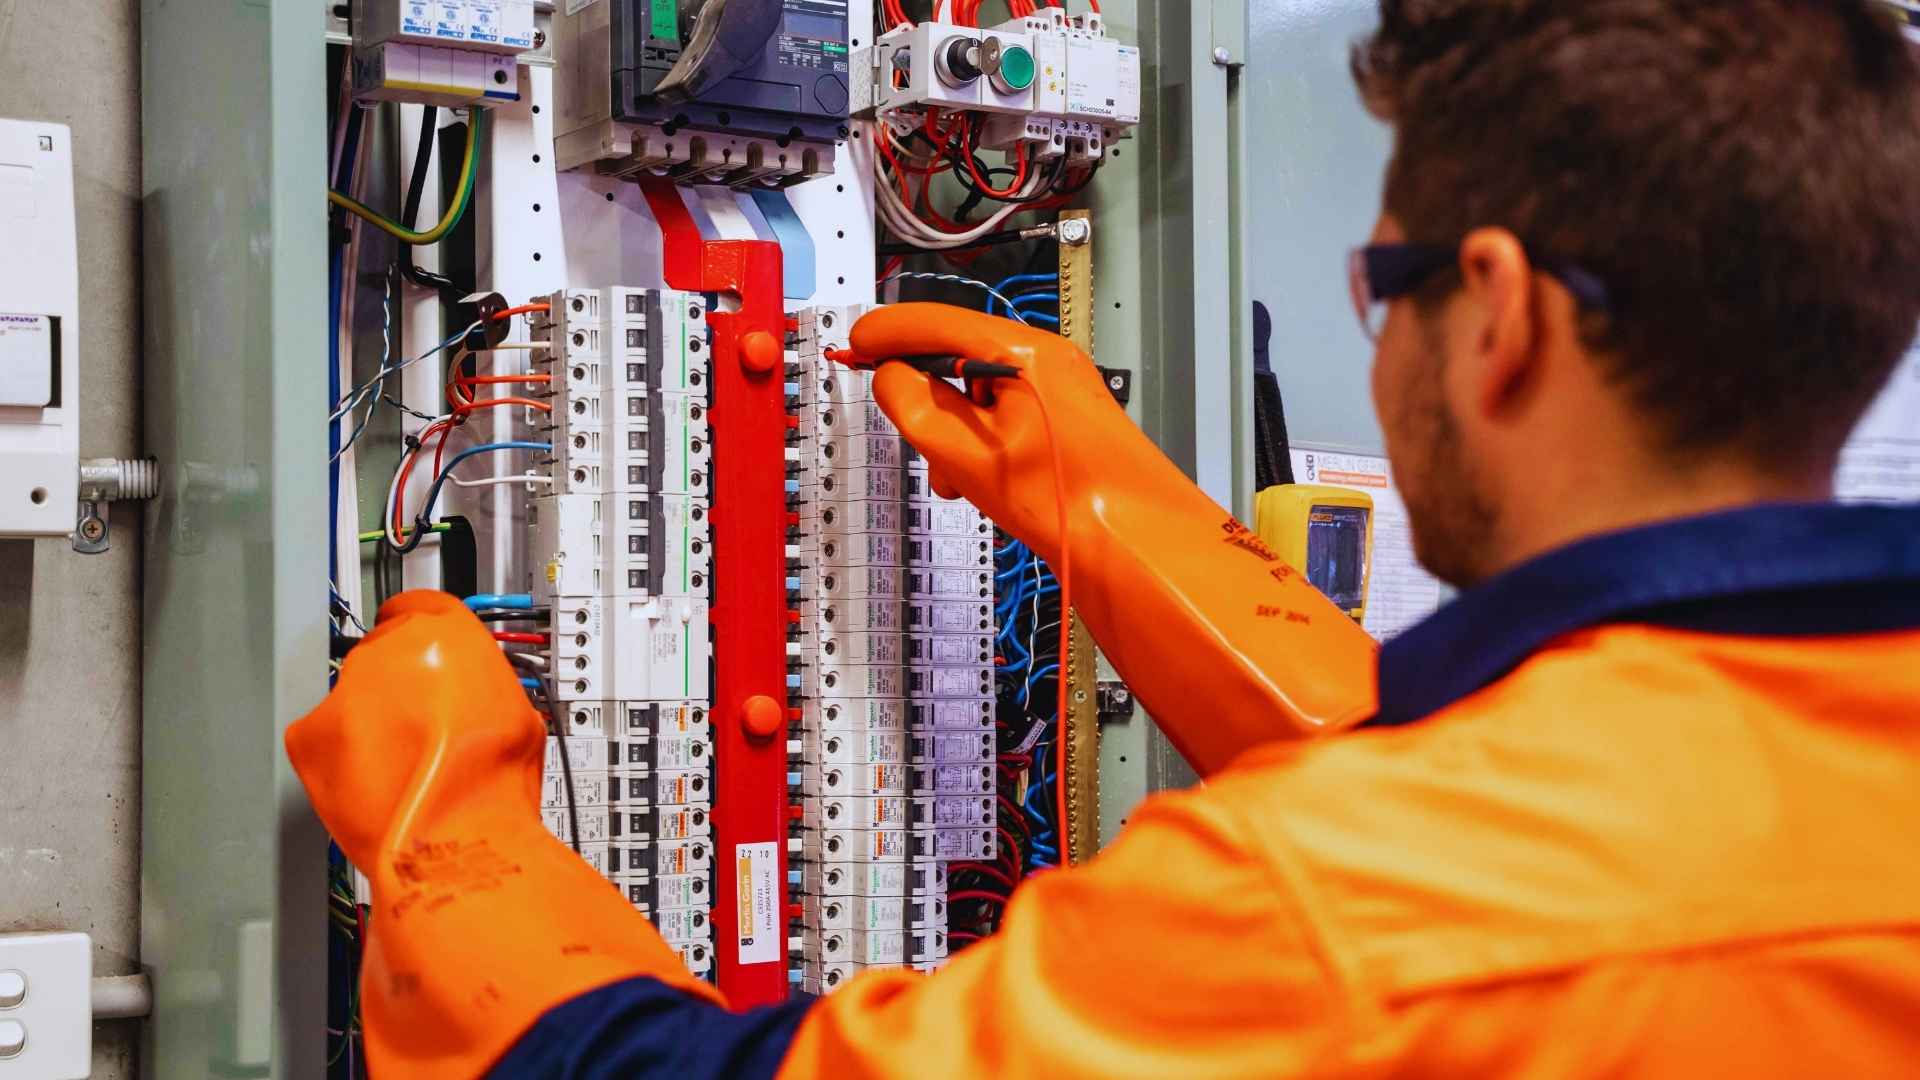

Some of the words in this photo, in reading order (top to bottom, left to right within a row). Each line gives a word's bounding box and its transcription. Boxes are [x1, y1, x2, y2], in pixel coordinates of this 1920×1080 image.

[403, 25, 432, 34] ERICO
[436, 28, 464, 38] ERICO
[470, 32, 498, 42] ERICO
[503, 36, 530, 46] ERICO
[742, 874, 751, 902] Gerin
[742, 904, 752, 934] Merlin
